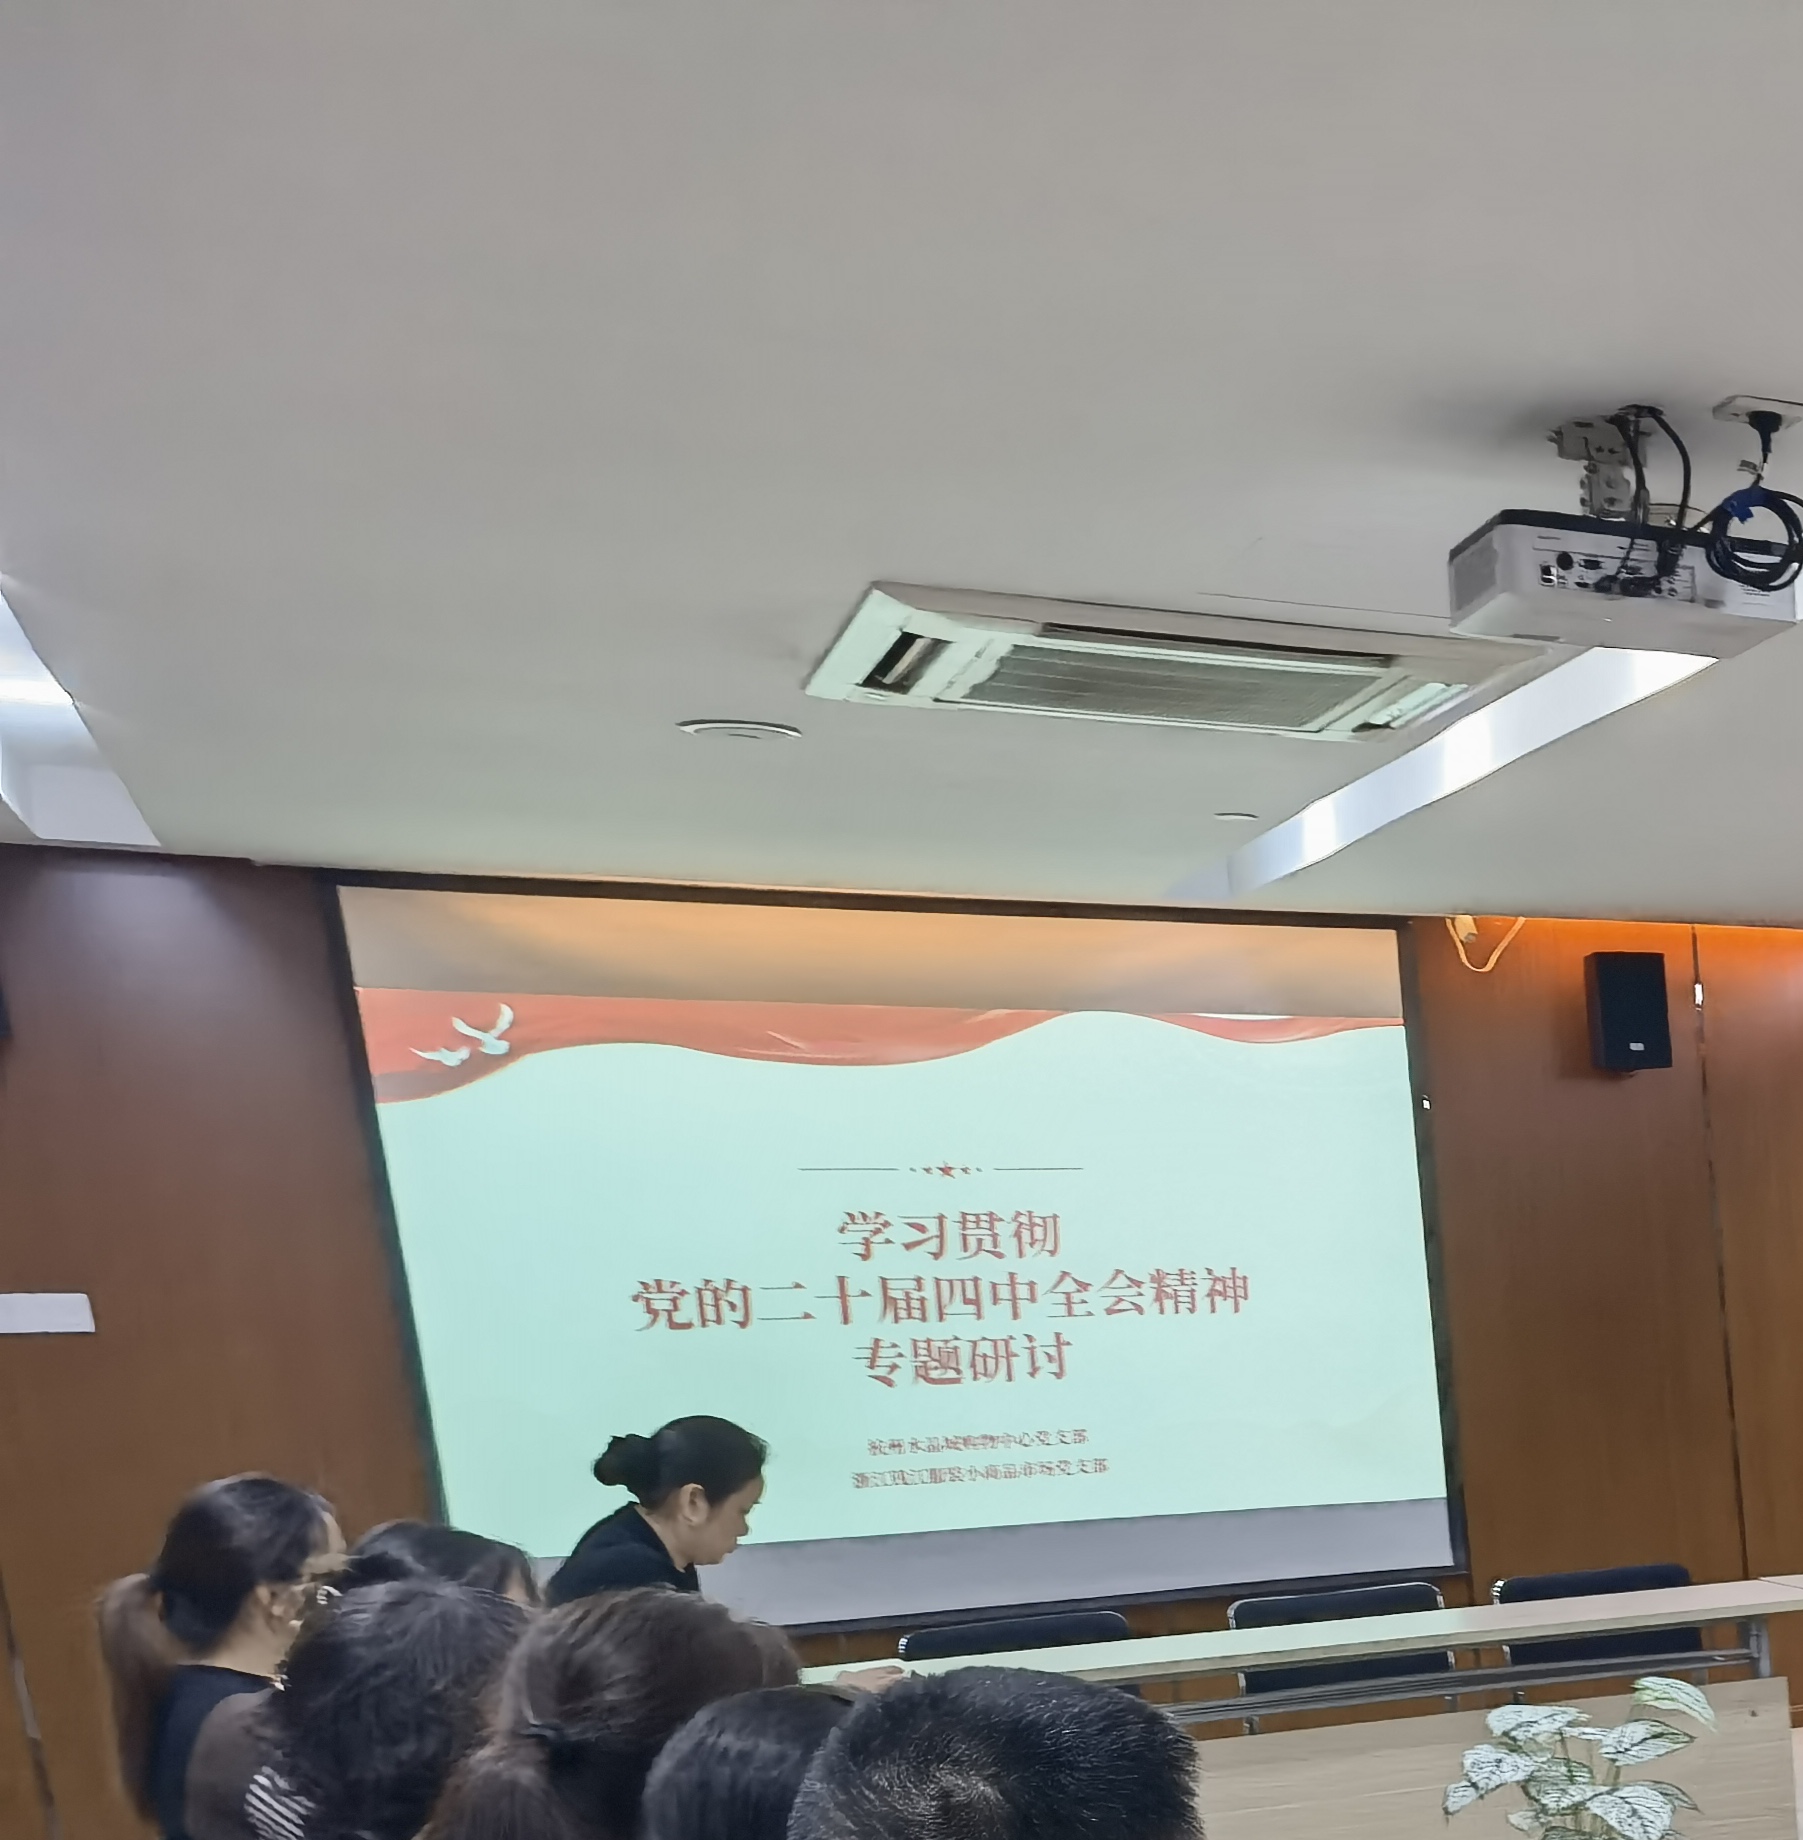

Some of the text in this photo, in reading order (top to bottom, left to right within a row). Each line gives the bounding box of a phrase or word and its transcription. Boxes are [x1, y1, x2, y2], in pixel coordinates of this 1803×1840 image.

[837, 1209, 1062, 1262] 学习贯彻
[632, 1266, 1251, 1333] 党的二十届四中全会精神
[852, 1331, 1073, 1388] 专题研讨
